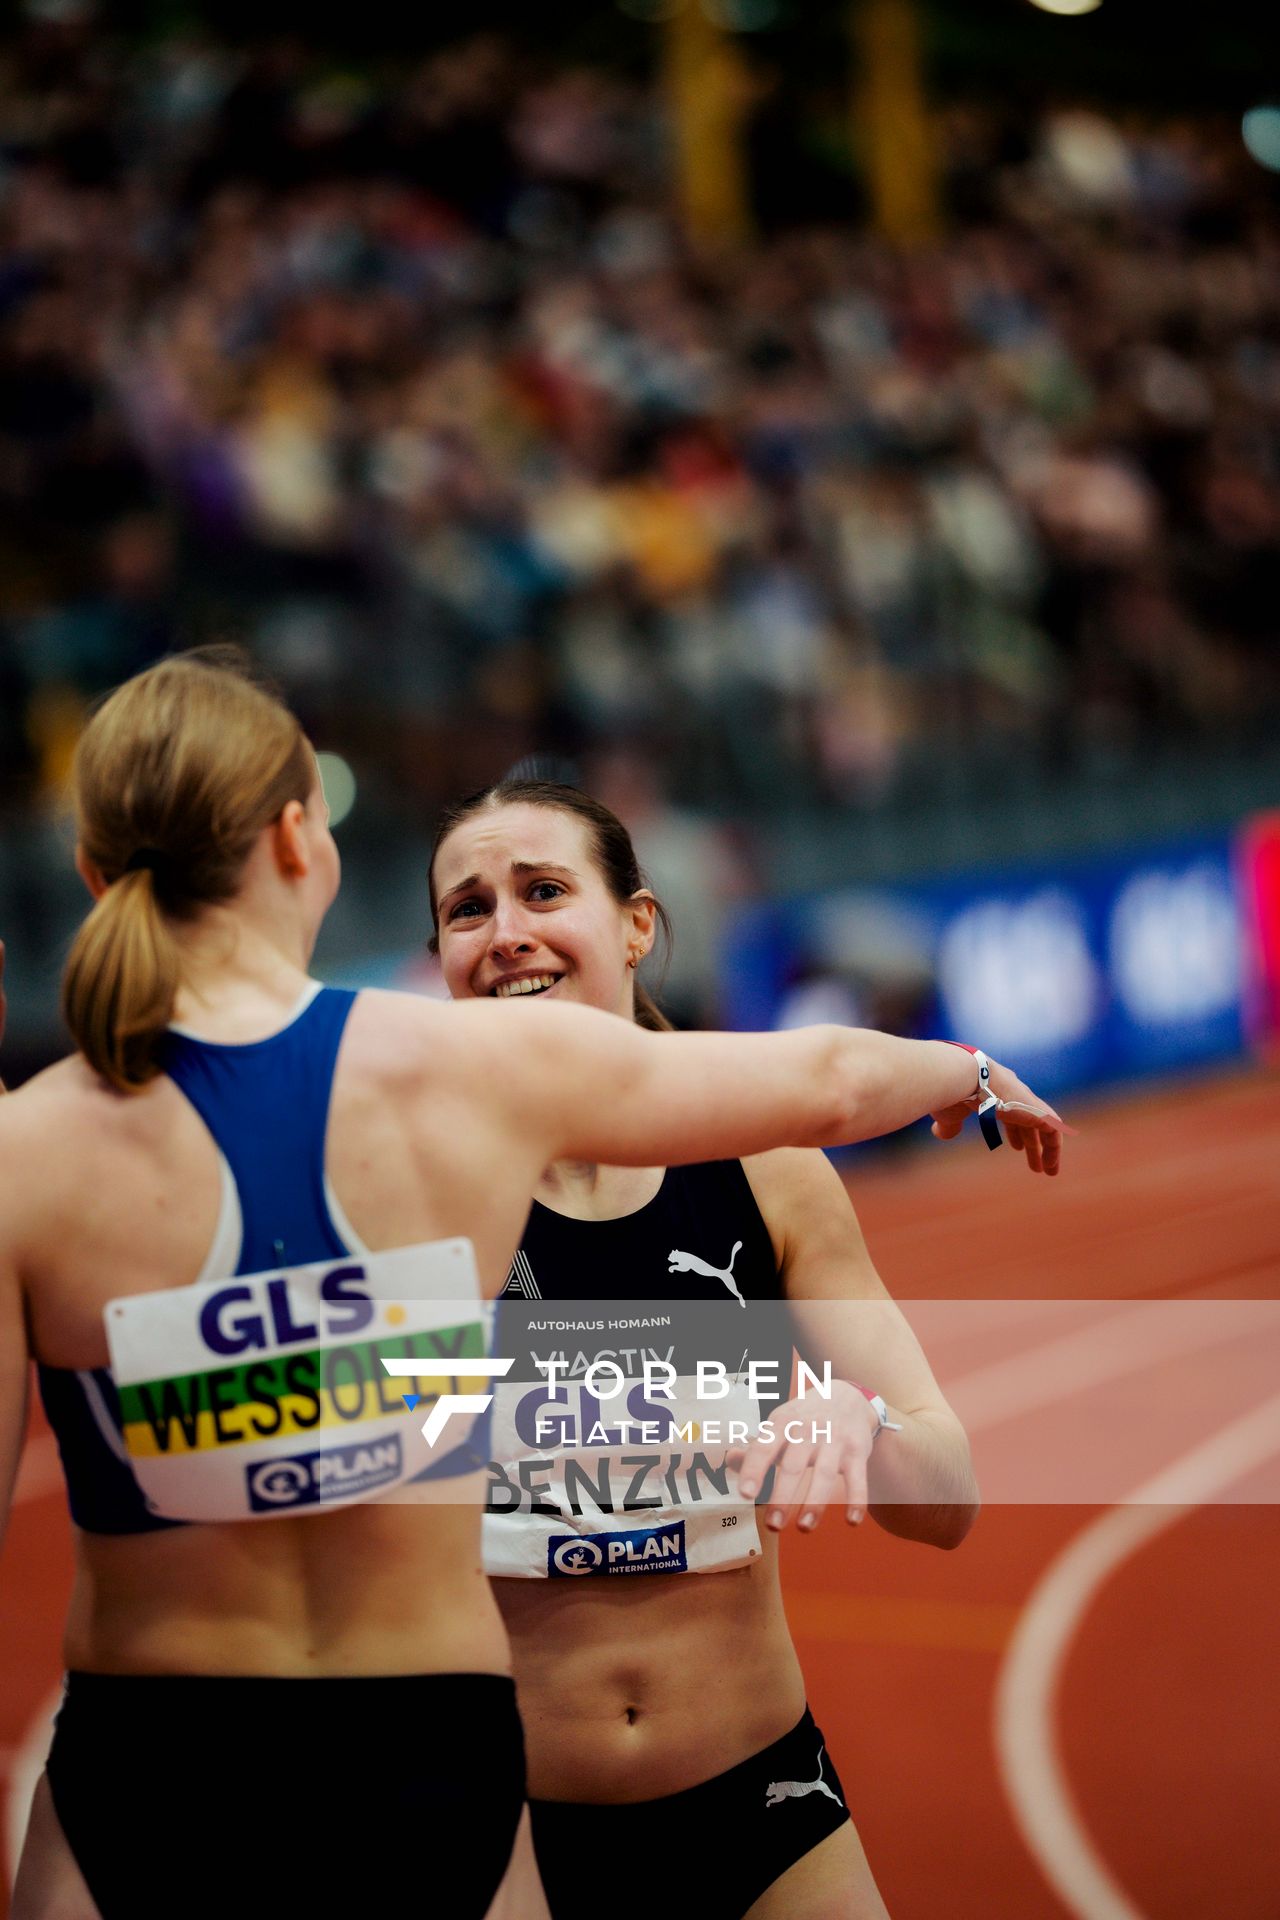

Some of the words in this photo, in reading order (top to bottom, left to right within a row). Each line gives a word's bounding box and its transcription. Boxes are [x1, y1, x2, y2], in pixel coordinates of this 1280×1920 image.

[527, 1320, 605, 1331] AUTOHAUS
[608, 1316, 671, 1329] HOMANN
[530, 1345, 675, 1378] VIACTIV
[138, 1326, 467, 1453] WESSOLLY
[312, 1443, 398, 1484] PLAN
[721, 1516, 737, 1528] 320
[608, 1534, 680, 1563] PLAN
[609, 1559, 681, 1574] INTERNATIONAL
